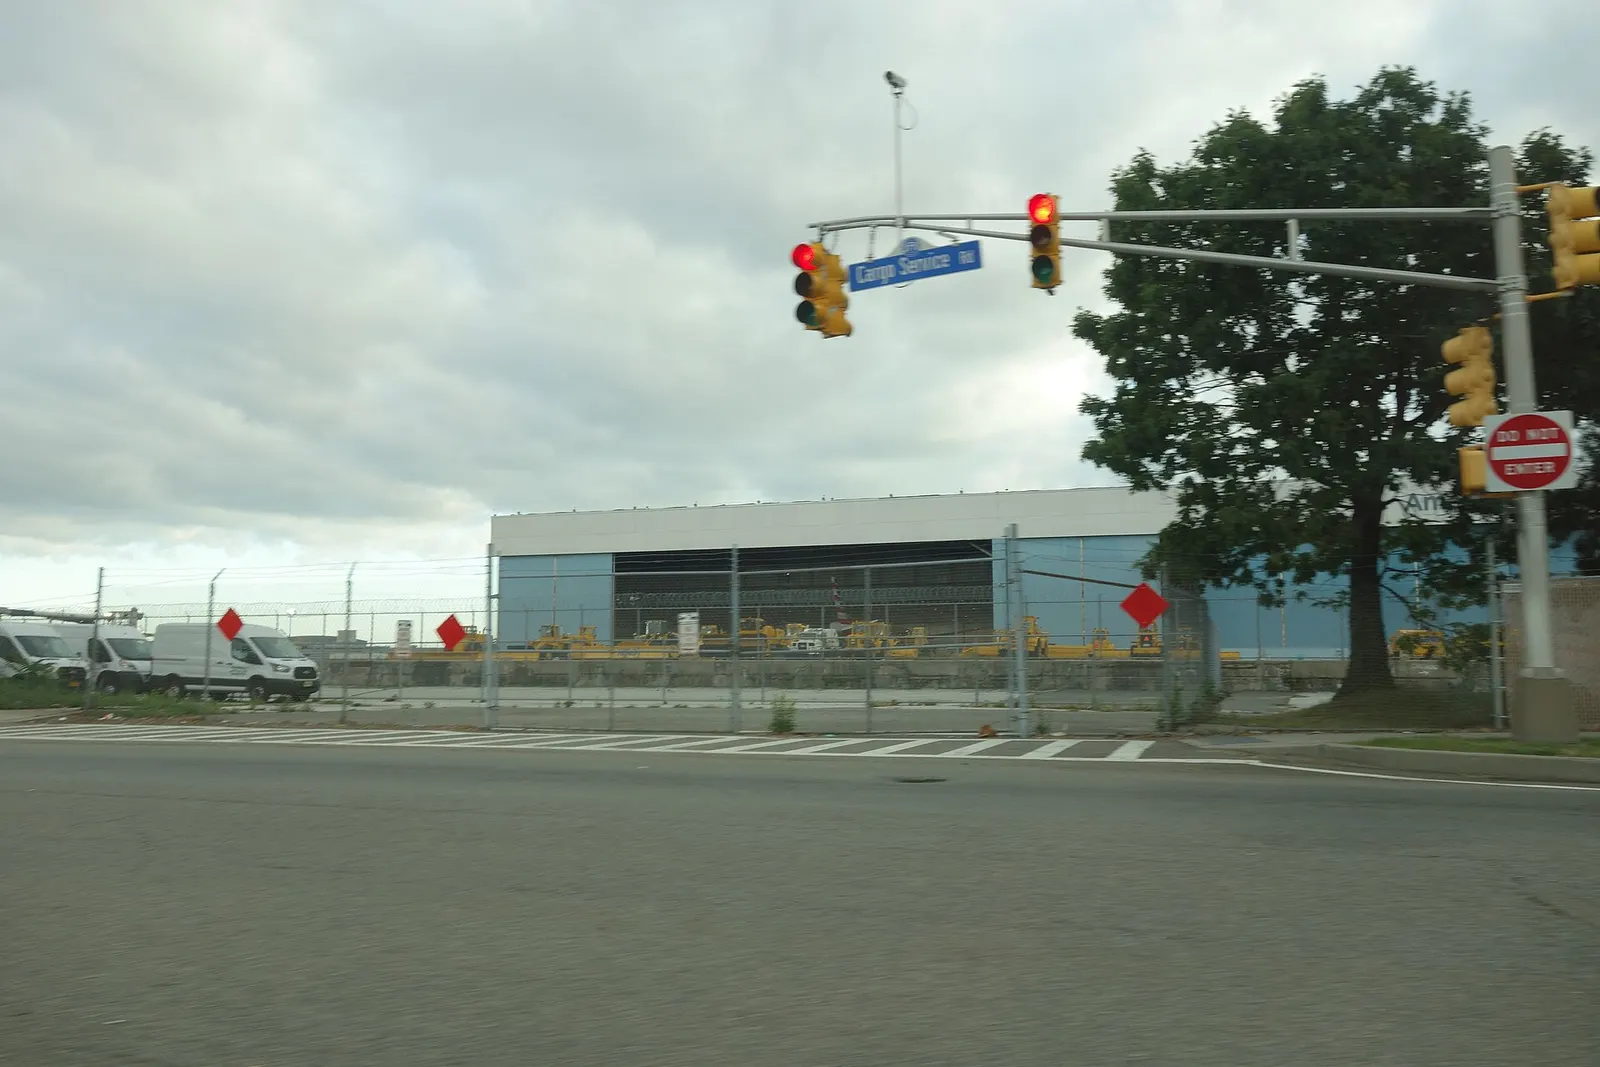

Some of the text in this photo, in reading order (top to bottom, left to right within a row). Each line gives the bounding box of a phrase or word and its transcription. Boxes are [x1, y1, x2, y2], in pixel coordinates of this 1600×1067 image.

[855, 263, 897, 284] Cargo
[897, 253, 950, 275] Service
[1496, 428, 1560, 442] DO NOT
[1504, 462, 1556, 475] ENTER
